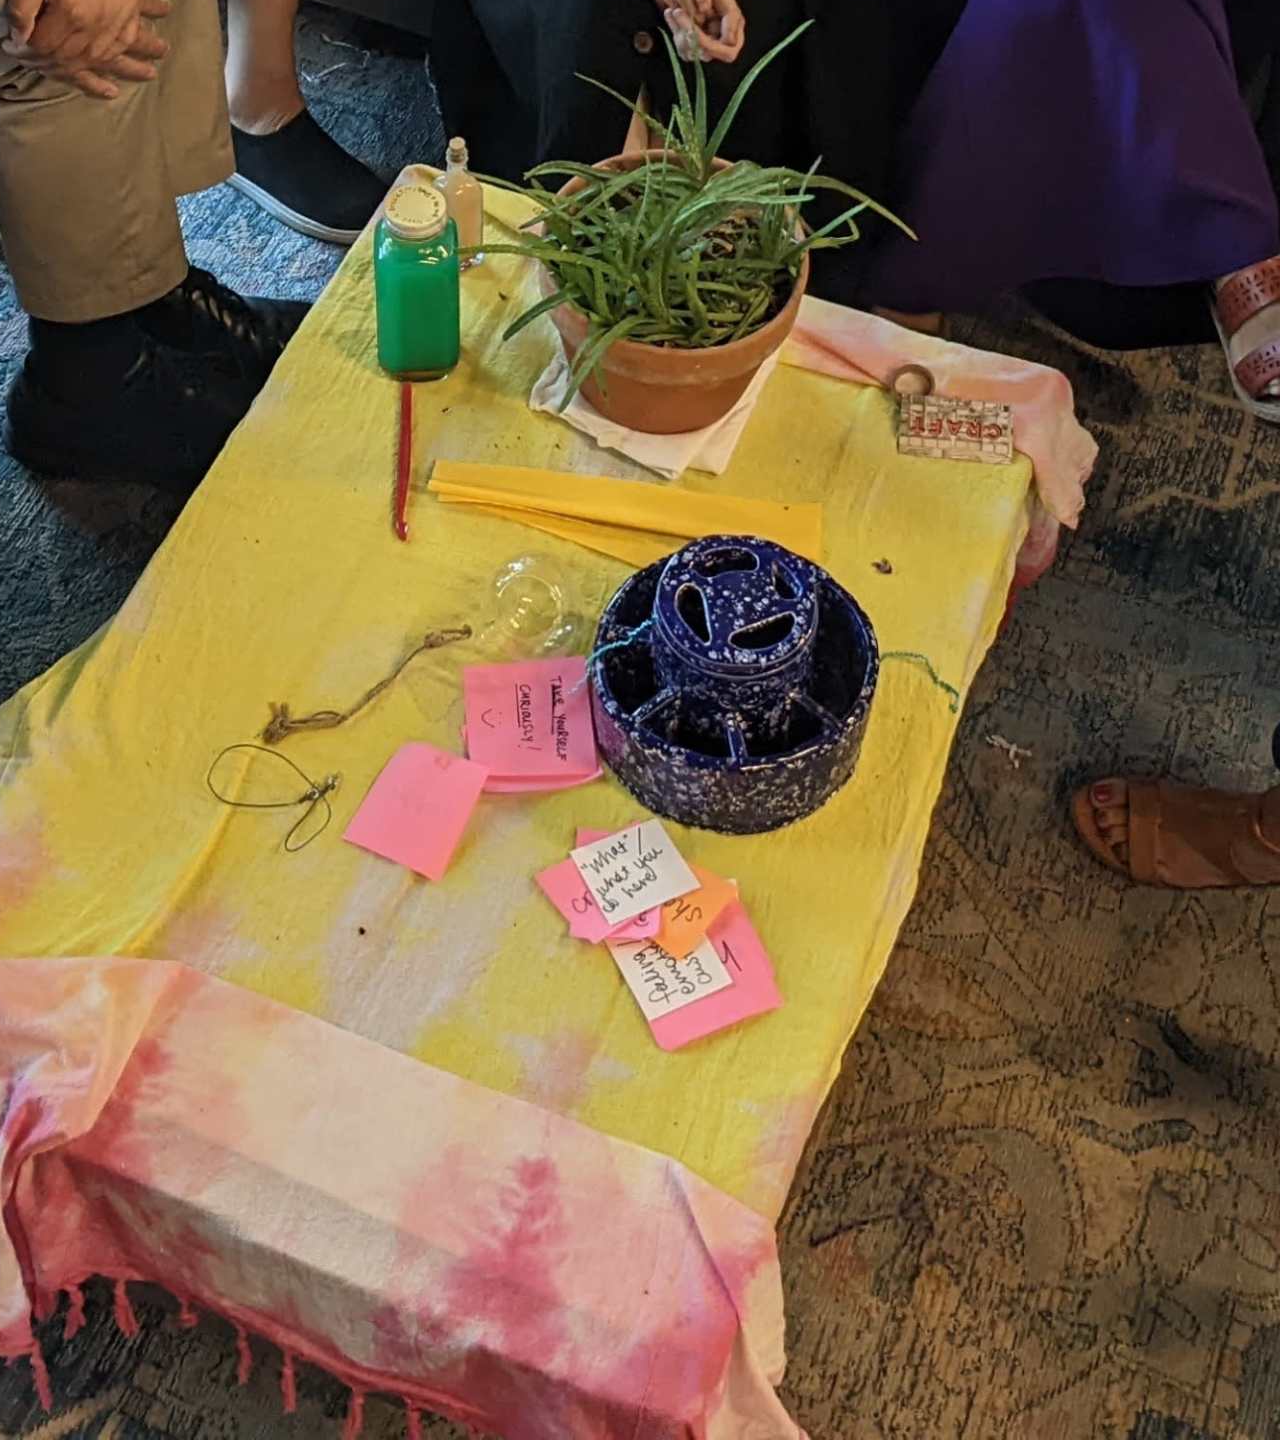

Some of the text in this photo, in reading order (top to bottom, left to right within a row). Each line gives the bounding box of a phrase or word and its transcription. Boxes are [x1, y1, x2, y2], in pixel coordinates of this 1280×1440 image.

[908, 415, 1002, 439] CRAFT
[552, 713, 569, 762] YOURSELF
[636, 848, 663, 874] you
